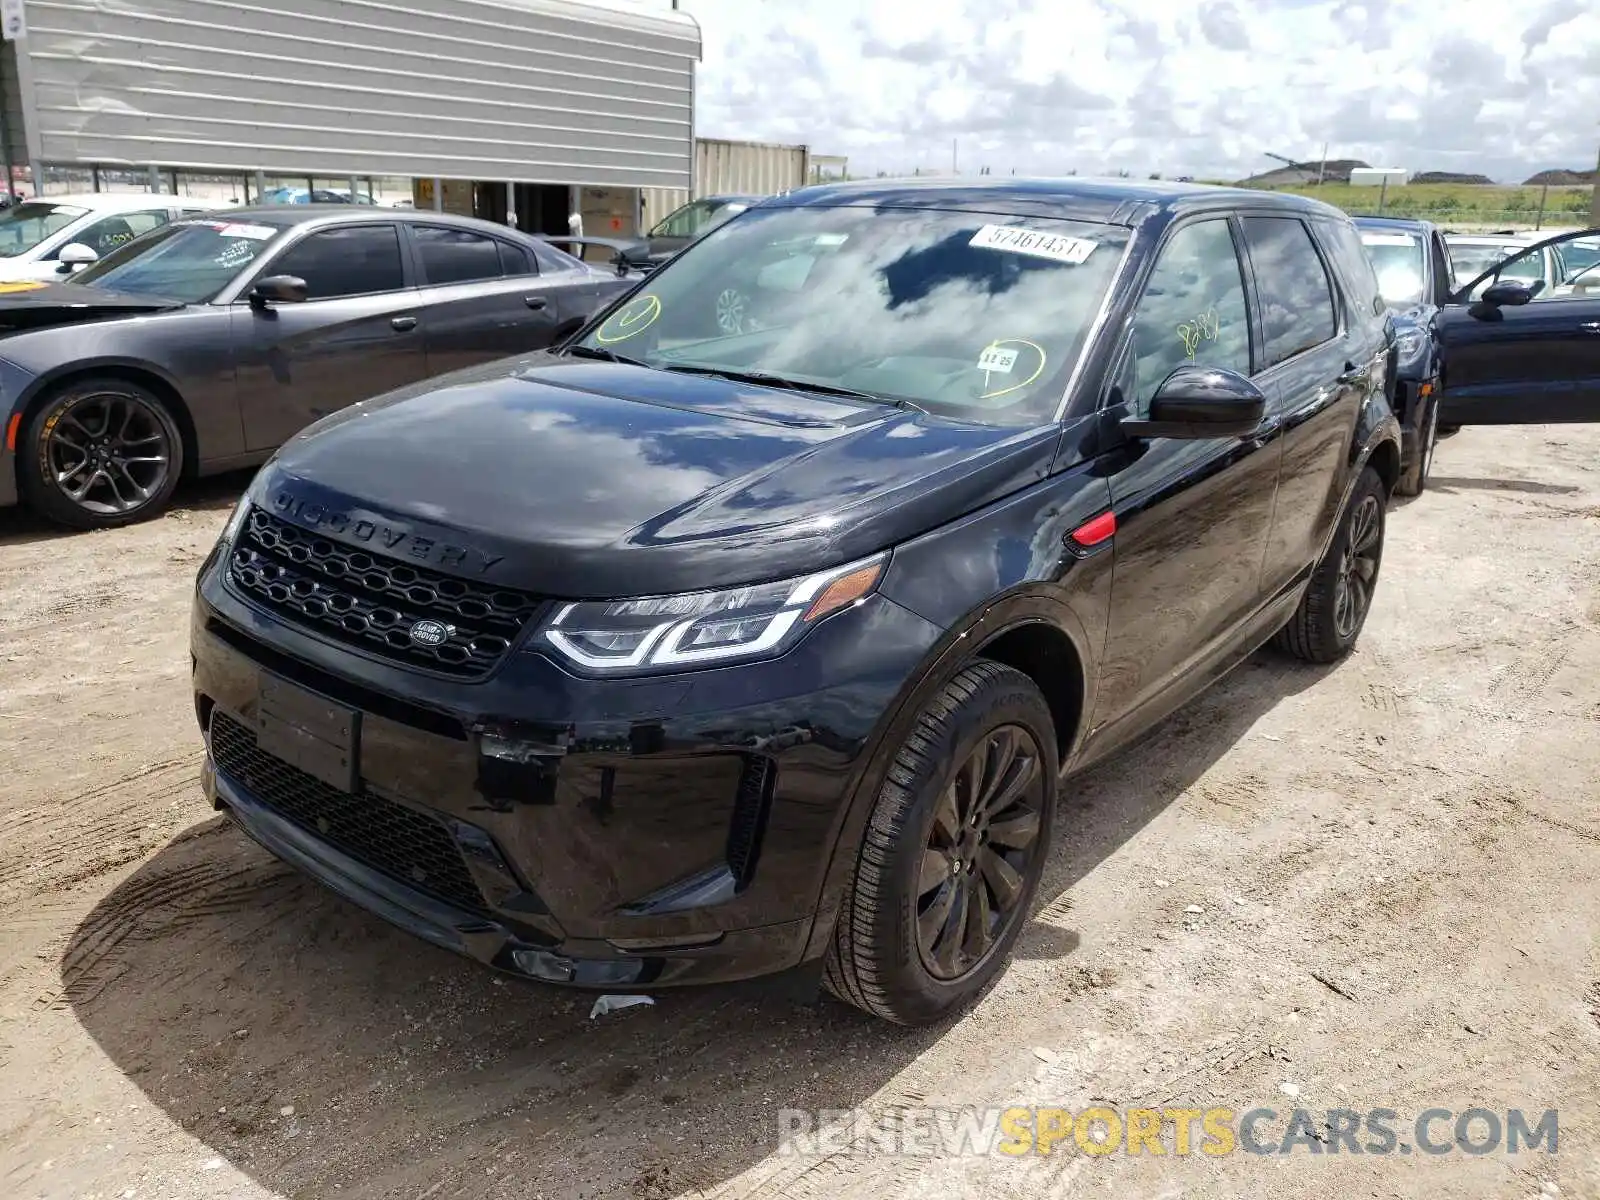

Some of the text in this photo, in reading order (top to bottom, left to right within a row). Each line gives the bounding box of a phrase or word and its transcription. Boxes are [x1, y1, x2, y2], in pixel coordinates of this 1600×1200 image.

[273, 490, 506, 574] DISCOVERY
[417, 622, 437, 634] LAND
[416, 630, 440, 643] ROVER
